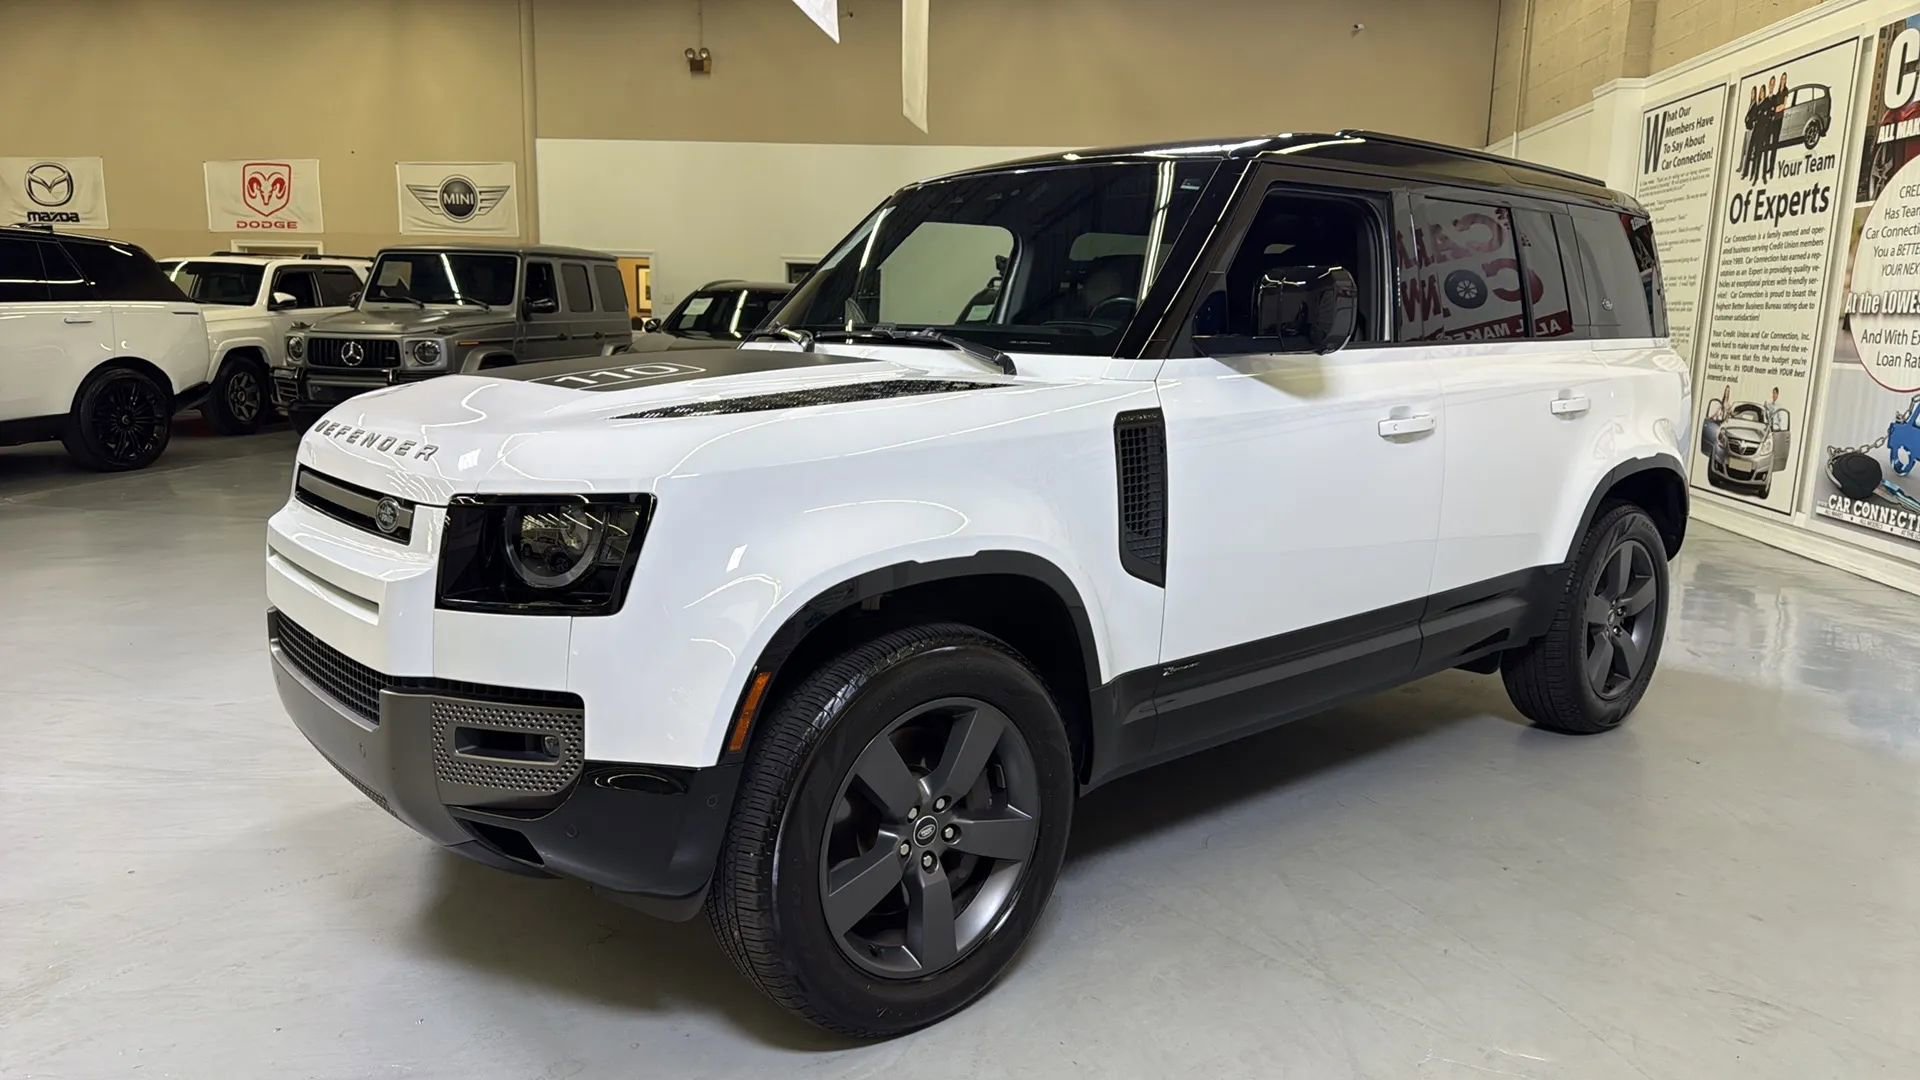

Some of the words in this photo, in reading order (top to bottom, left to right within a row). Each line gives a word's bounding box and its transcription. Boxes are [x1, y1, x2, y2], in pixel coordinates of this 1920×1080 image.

[1679, 106, 1691, 119] Our
[1665, 121, 1695, 138] Members
[1696, 115, 1714, 129] Have
[1877, 122, 1896, 144] ALL
[1664, 143, 1671, 154] To
[1672, 140, 1684, 153] Say
[1684, 133, 1706, 149] About
[1661, 159, 1672, 171] Car
[1673, 146, 1714, 168] Connection!
[1778, 160, 1803, 179] Your
[1805, 154, 1835, 174] Team
[443, 193, 474, 205] MINI
[1729, 188, 1753, 224] Of
[1754, 182, 1831, 228] Experts
[1884, 207, 1900, 220] Has
[236, 220, 298, 229] DODGE
[1865, 227, 1879, 240] Car
[1873, 245, 1889, 258] You
[1890, 247, 1895, 256] a
[1881, 263, 1902, 277] YOUR
[1845, 291, 1858, 314] At
[1859, 291, 1880, 314] the
[1861, 329, 1882, 344] And
[1884, 329, 1908, 345] With
[1876, 350, 1901, 367] Loan
[554, 365, 680, 384] 110
[314, 419, 440, 461] DEFENDER
[1828, 494, 1851, 513] CAR
